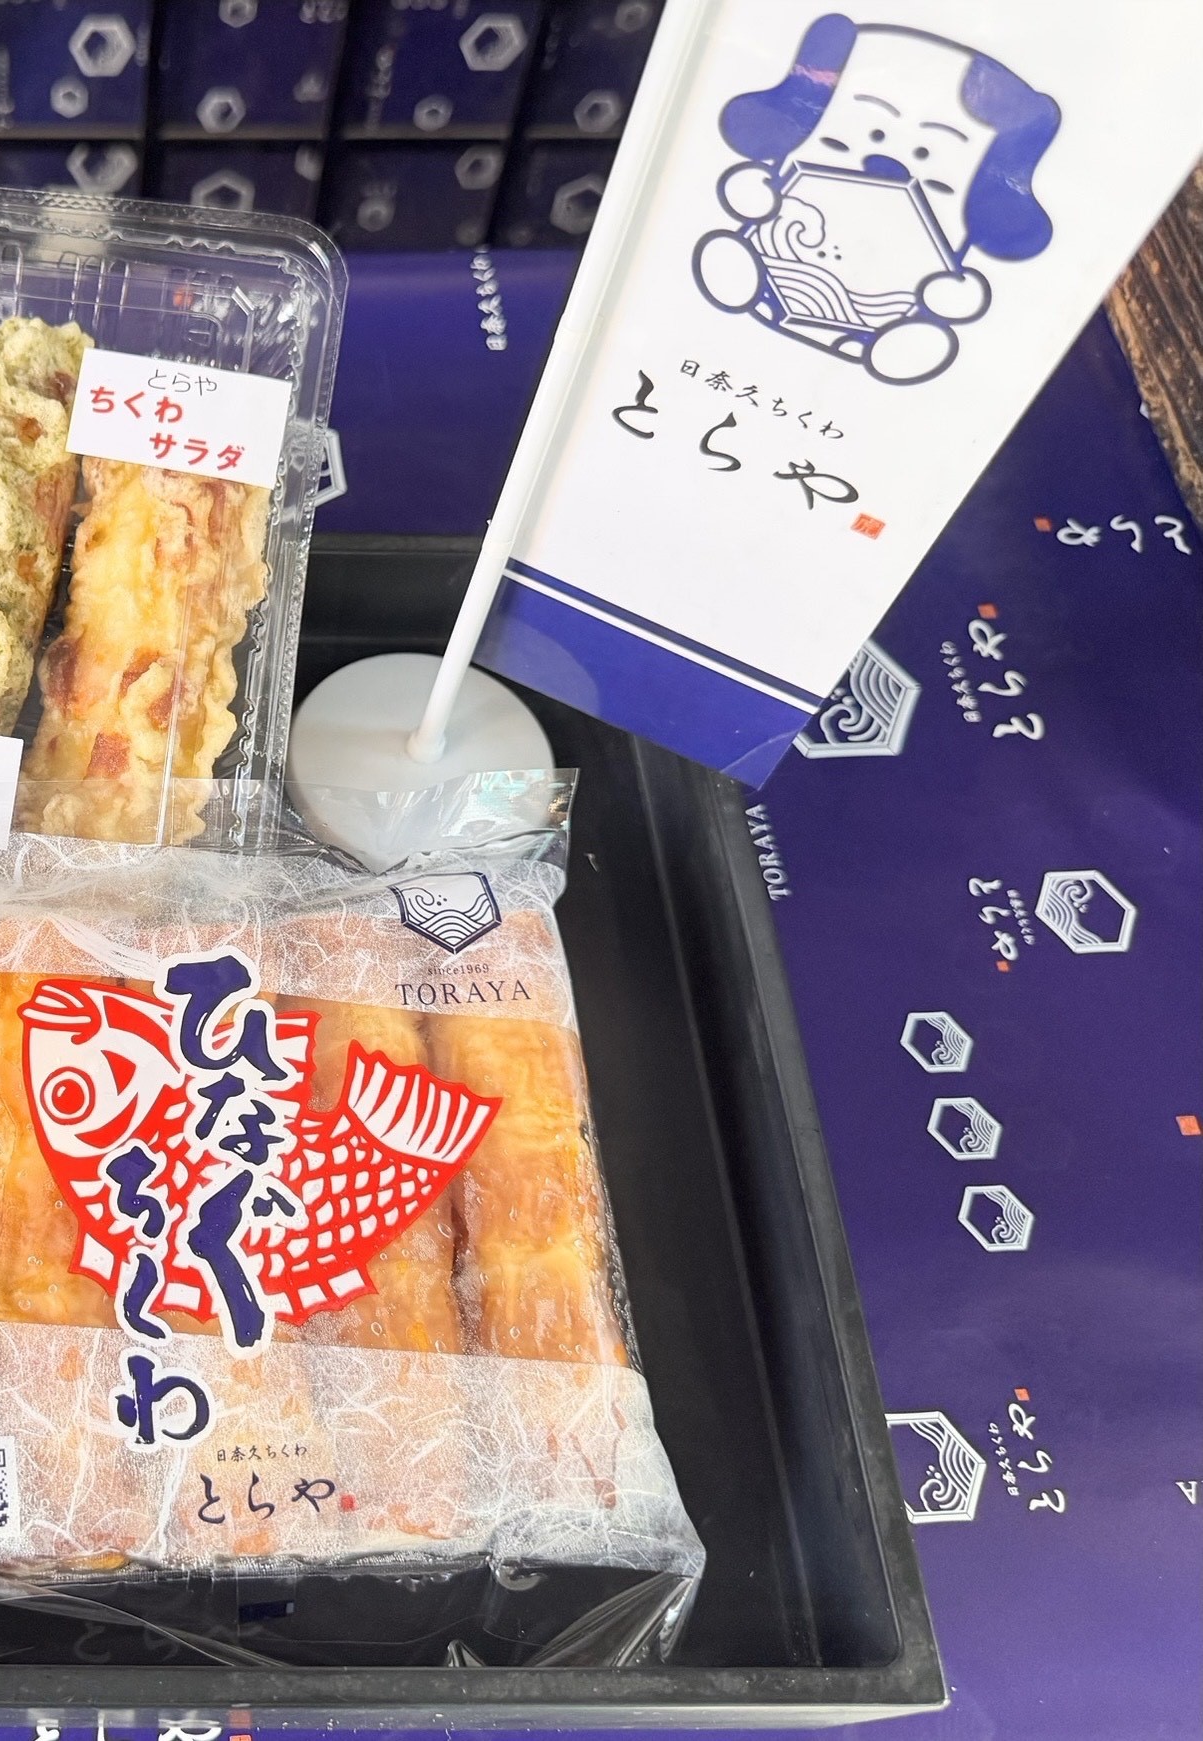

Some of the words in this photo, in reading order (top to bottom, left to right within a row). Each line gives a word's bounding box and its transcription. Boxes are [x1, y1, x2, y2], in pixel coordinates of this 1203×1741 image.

[89, 385, 184, 424] ちくわ
[147, 368, 218, 397] とらや
[679, 359, 845, 440] 日奈久ちくわ
[149, 431, 246, 472] サラダ
[611, 369, 859, 511] とらや
[1056, 514, 1192, 556] とらや
[968, 619, 1046, 741] とらや
[745, 804, 792, 901] TORAYA
[968, 877, 1019, 961] とらや
[394, 979, 532, 1006] TORAYA
[427, 963, 490, 977] since1969
[163, 954, 296, 1348] ひなぐ
[105, 1145, 211, 1444] ちくわ
[216, 1443, 308, 1463] 日奈久ちくわ
[1008, 1403, 1066, 1514] とらや
[197, 1470, 336, 1524] とらや
